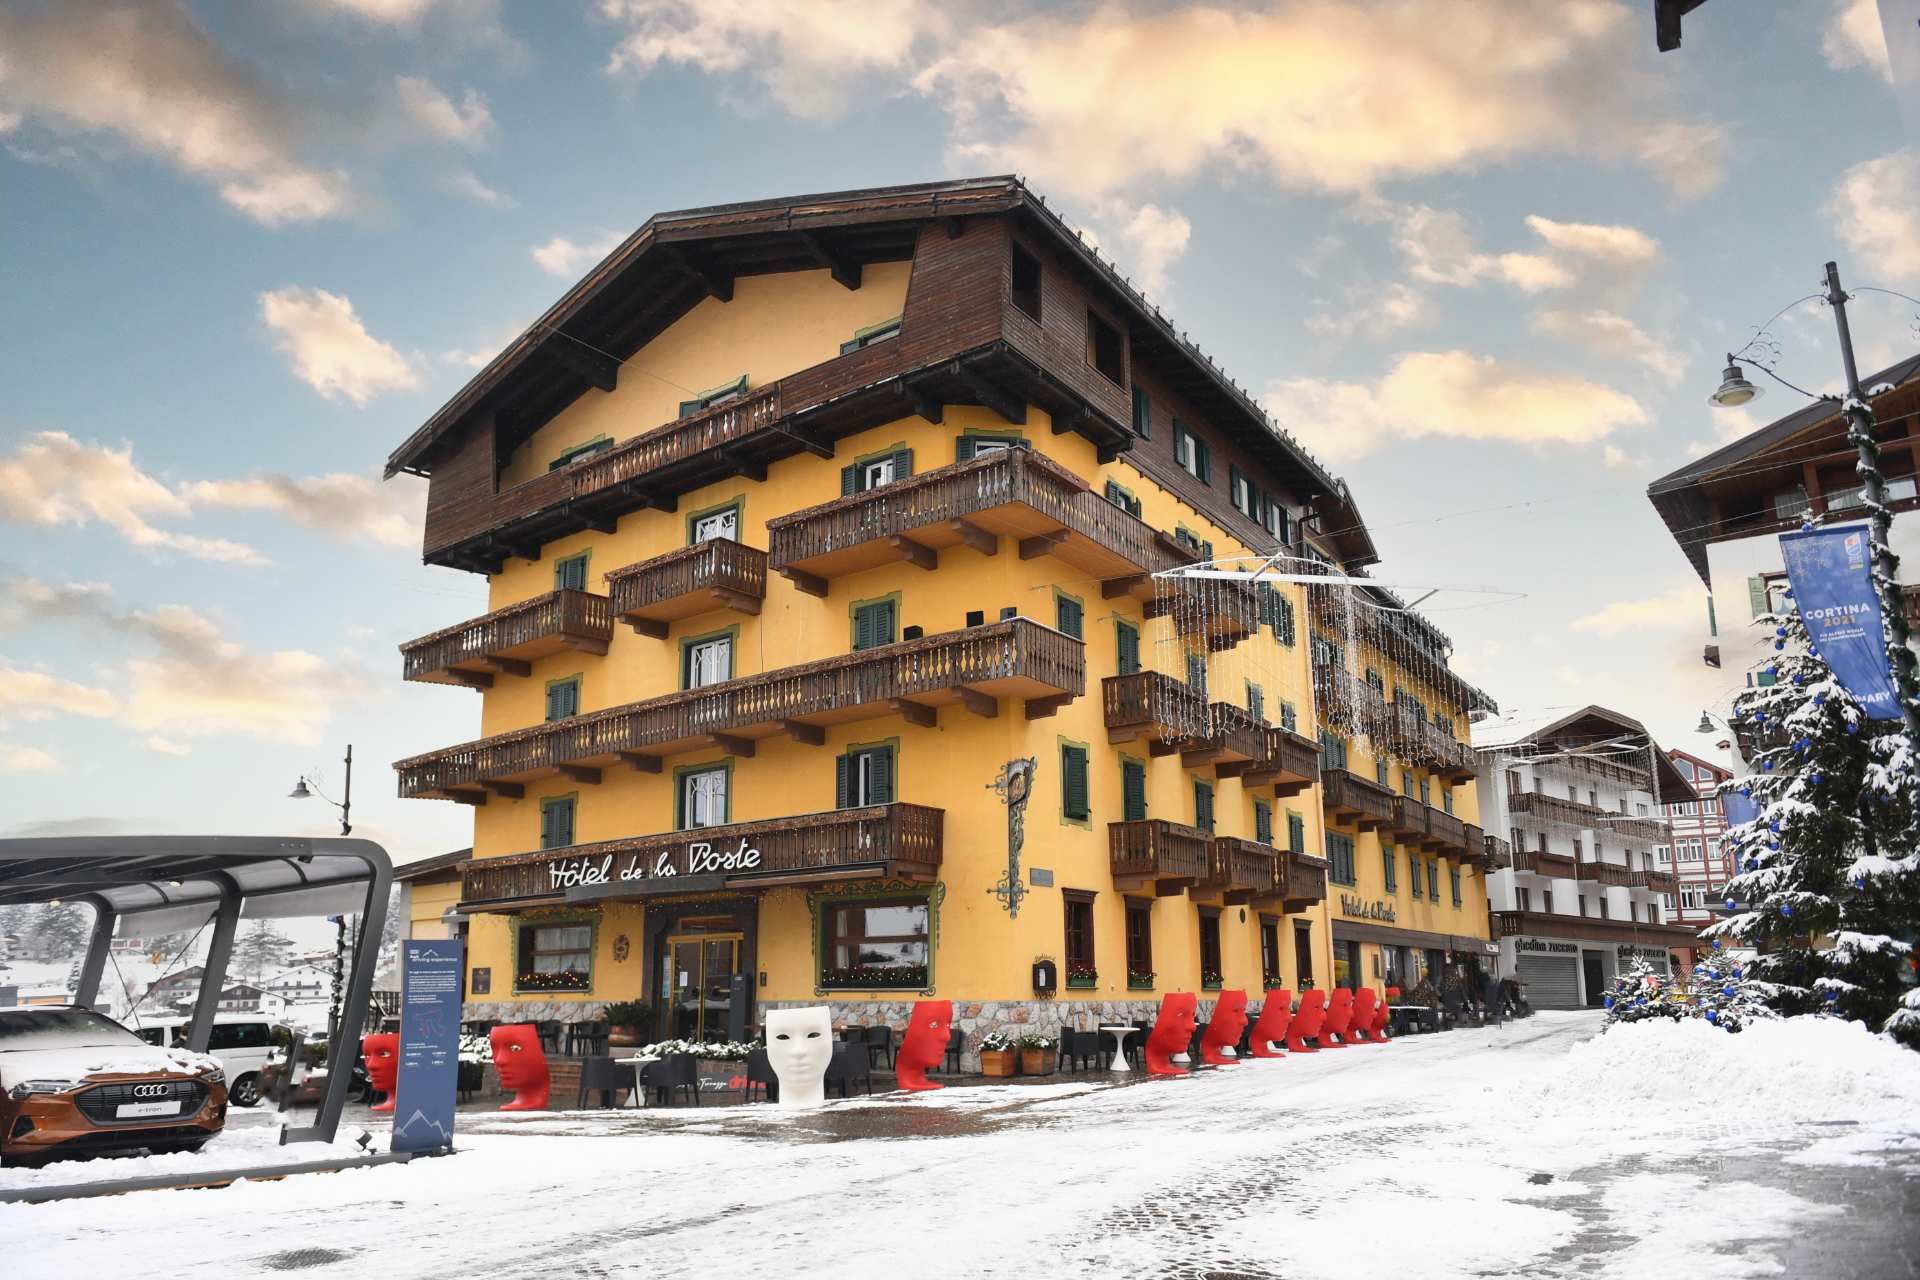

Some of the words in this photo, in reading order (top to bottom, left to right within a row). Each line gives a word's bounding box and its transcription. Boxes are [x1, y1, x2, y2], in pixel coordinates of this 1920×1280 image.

[1805, 602, 1870, 620] CORTINA
[1823, 615, 1856, 627] 2021
[549, 854, 612, 889] Hôtel
[620, 856, 642, 881] de
[651, 851, 677, 878] la
[689, 837, 761, 874] Poste
